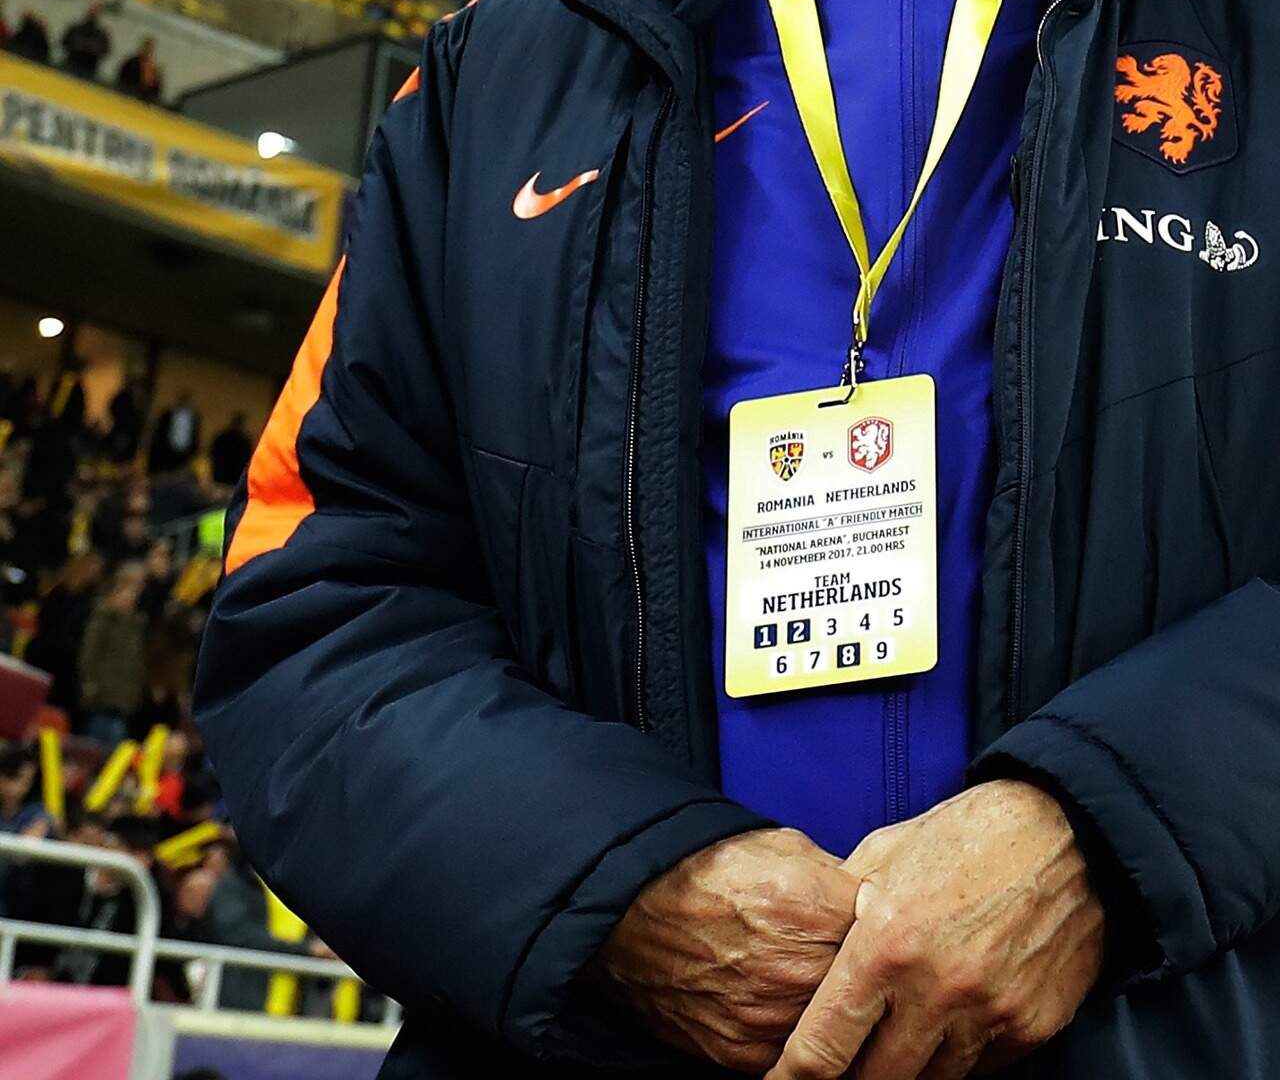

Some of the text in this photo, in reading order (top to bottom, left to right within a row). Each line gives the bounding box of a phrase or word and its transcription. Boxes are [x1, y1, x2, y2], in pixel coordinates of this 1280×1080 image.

[757, 480, 916, 514] ROMANIA NETHERLANDS
[743, 520, 819, 540] INTERNATIONAL
[841, 510, 887, 526] FRIENDLY
[888, 504, 923, 518] MATCH
[755, 540, 807, 557] "NATIONAL
[852, 525, 910, 542] BUCHAREST
[760, 560, 771, 570] 14
[773, 552, 826, 568] NOVEMBER
[856, 544, 884, 556] 21.00
[885, 540, 905, 552] HRS
[762, 578, 902, 614] NETHERLANDS
[814, 572, 850, 589] TEAM
[759, 608, 904, 647] 1 2 3 4 5
[776, 641, 888, 673] 6 7 8 9
